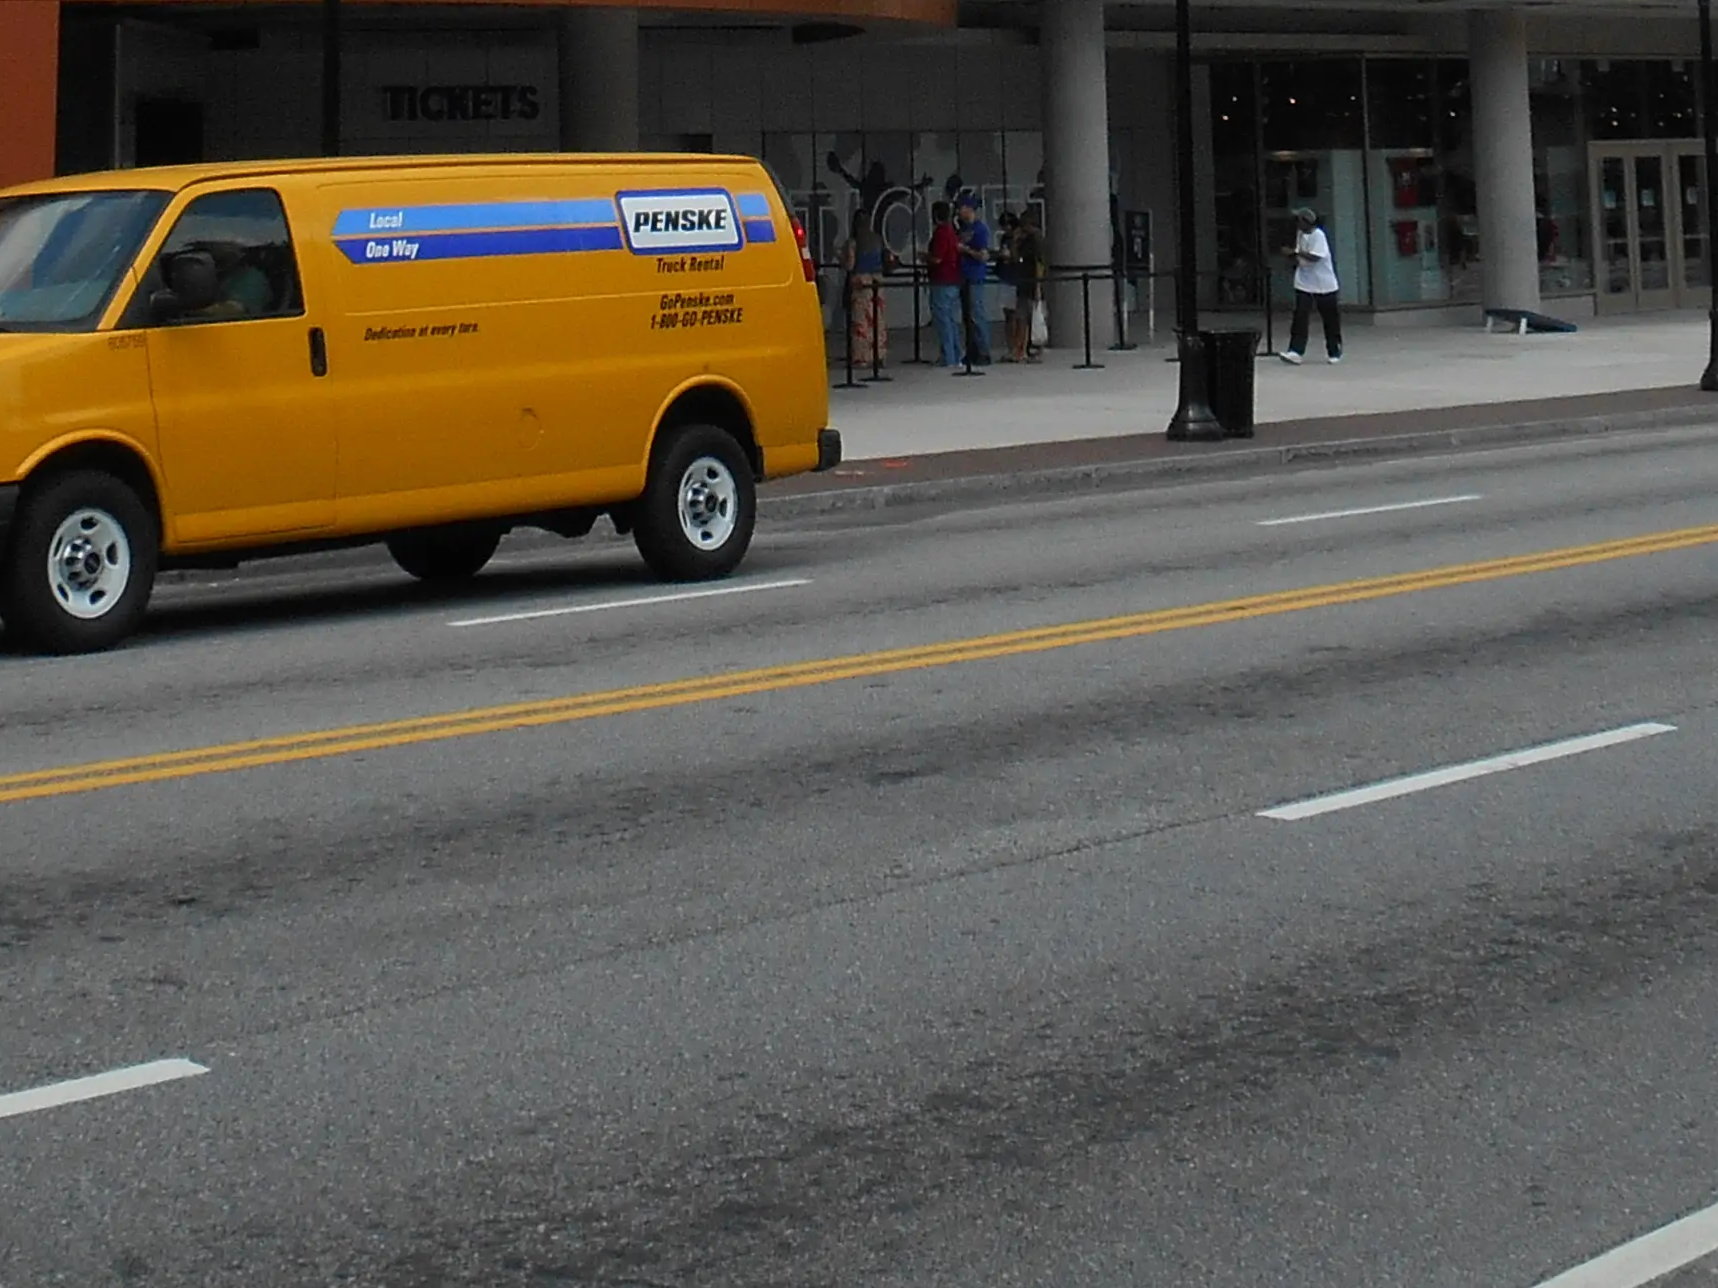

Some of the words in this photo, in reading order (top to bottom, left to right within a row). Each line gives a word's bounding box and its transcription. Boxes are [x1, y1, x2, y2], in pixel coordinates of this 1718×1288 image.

[383, 85, 540, 121] TICKETS
[370, 211, 403, 229] Local
[633, 209, 727, 233] PENSKE
[366, 241, 390, 258] One
[392, 239, 419, 259] Way
[657, 256, 687, 273] Truck
[689, 255, 724, 272] Rental
[660, 293, 735, 310] GoPenske.com
[651, 308, 743, 329] 1-800-GO-PENSKE
[364, 327, 416, 341] Dedication
[418, 325, 429, 337] at
[430, 324, 456, 337] every
